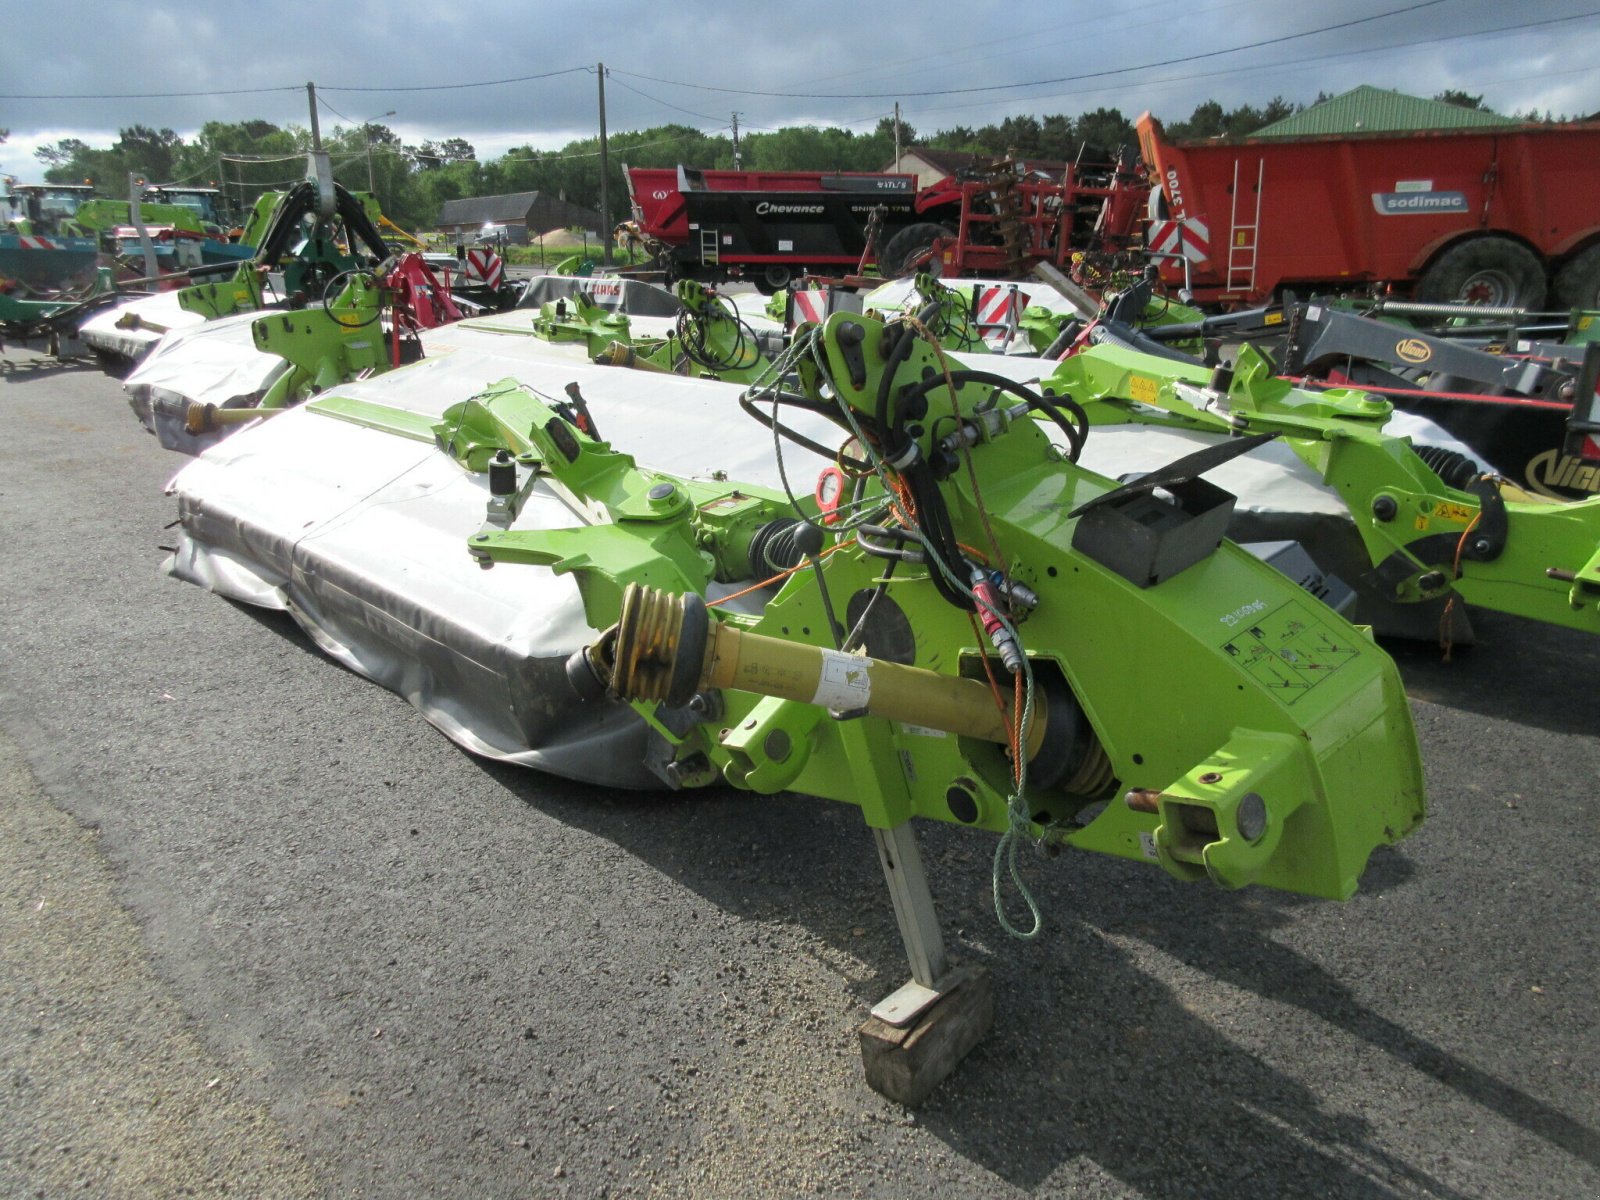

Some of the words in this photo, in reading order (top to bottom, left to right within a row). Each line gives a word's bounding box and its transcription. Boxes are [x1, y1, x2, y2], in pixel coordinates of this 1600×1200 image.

[1167, 170, 1182, 206] 3700
[755, 201, 825, 215] Chevance
[1387, 196, 1462, 208] sodimac
[591, 284, 620, 296] CLAAS
[1400, 338, 1427, 359] Vicon
